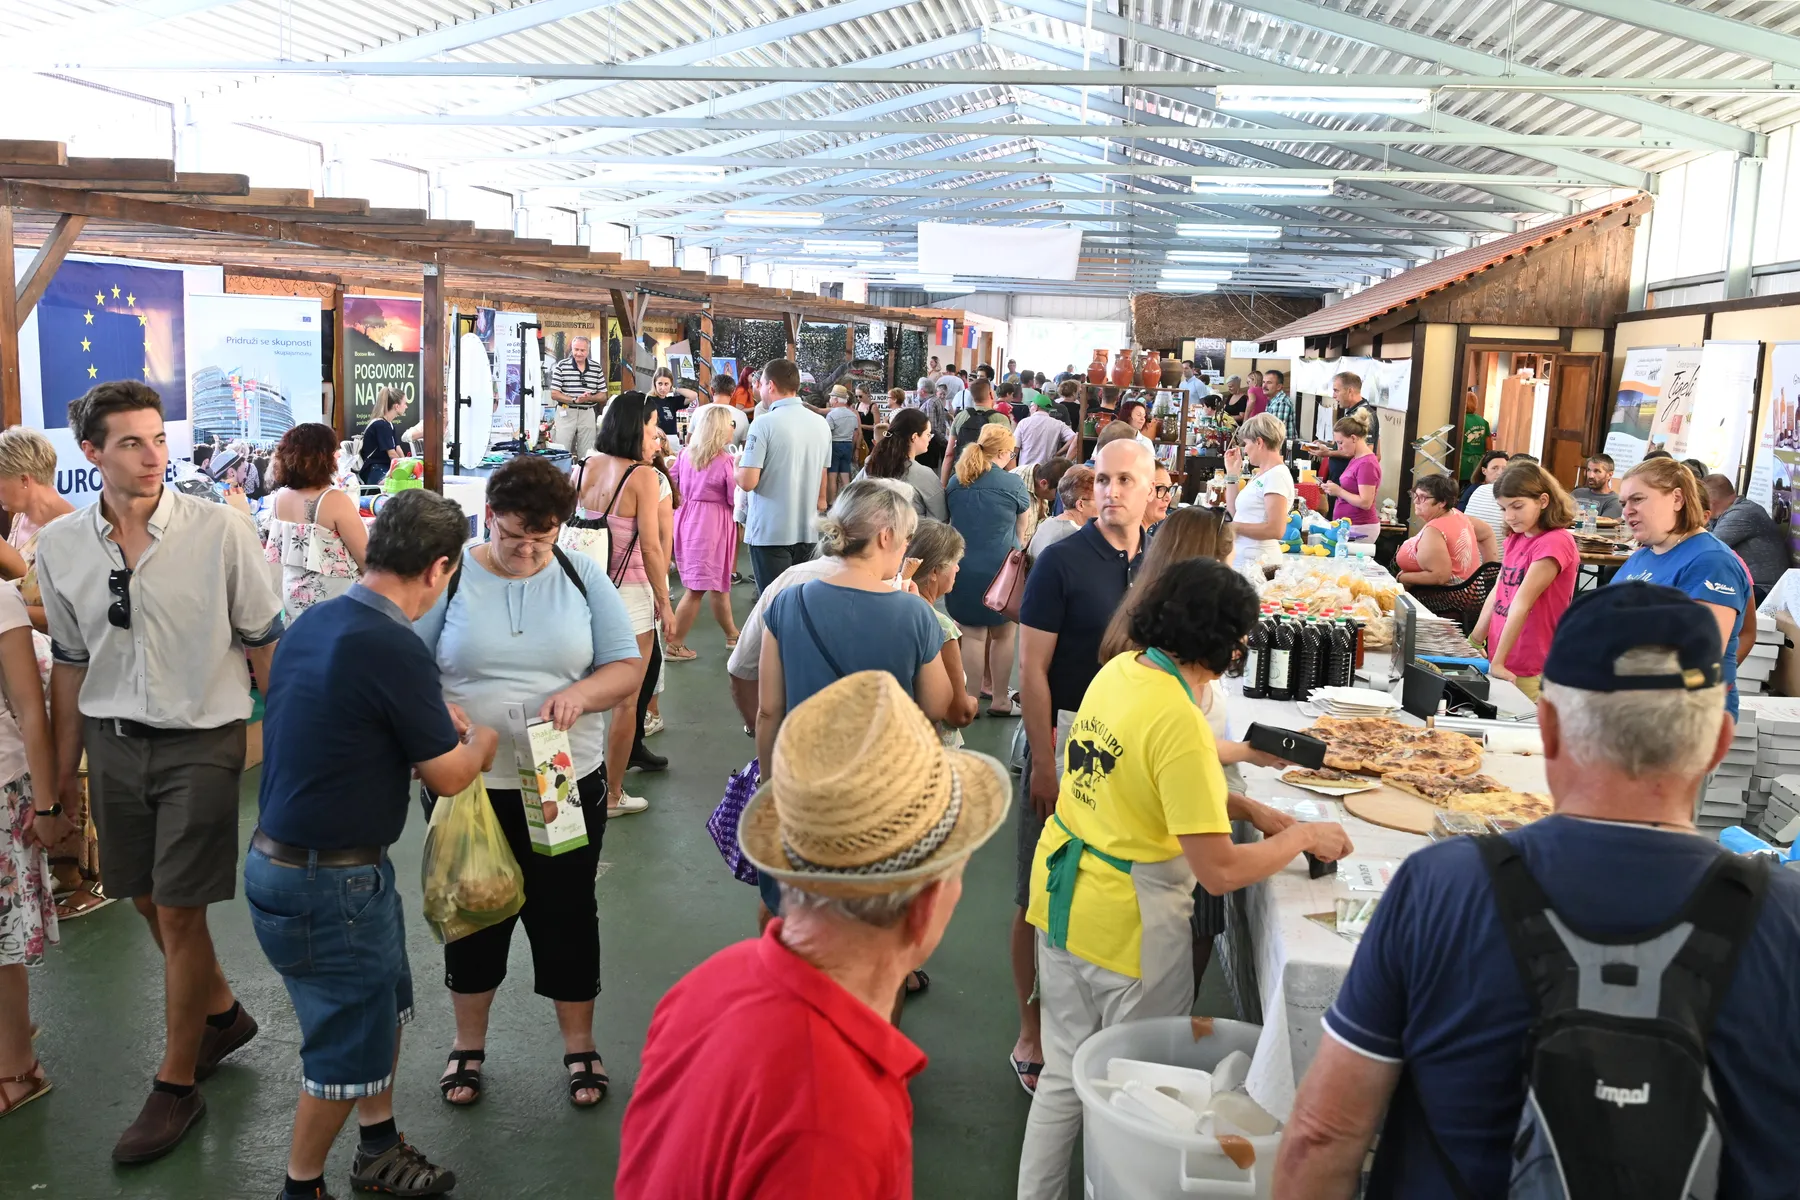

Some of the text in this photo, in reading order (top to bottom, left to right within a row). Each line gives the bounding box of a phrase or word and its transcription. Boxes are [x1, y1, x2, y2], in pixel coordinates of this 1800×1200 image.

[226, 336, 312, 347] Pridruži se skupnosti
[354, 363, 415, 380] POGOVORI Z
[355, 381, 415, 406] NARO
[56, 466, 104, 495] URO
[1101, 727, 1124, 758] LIPO
